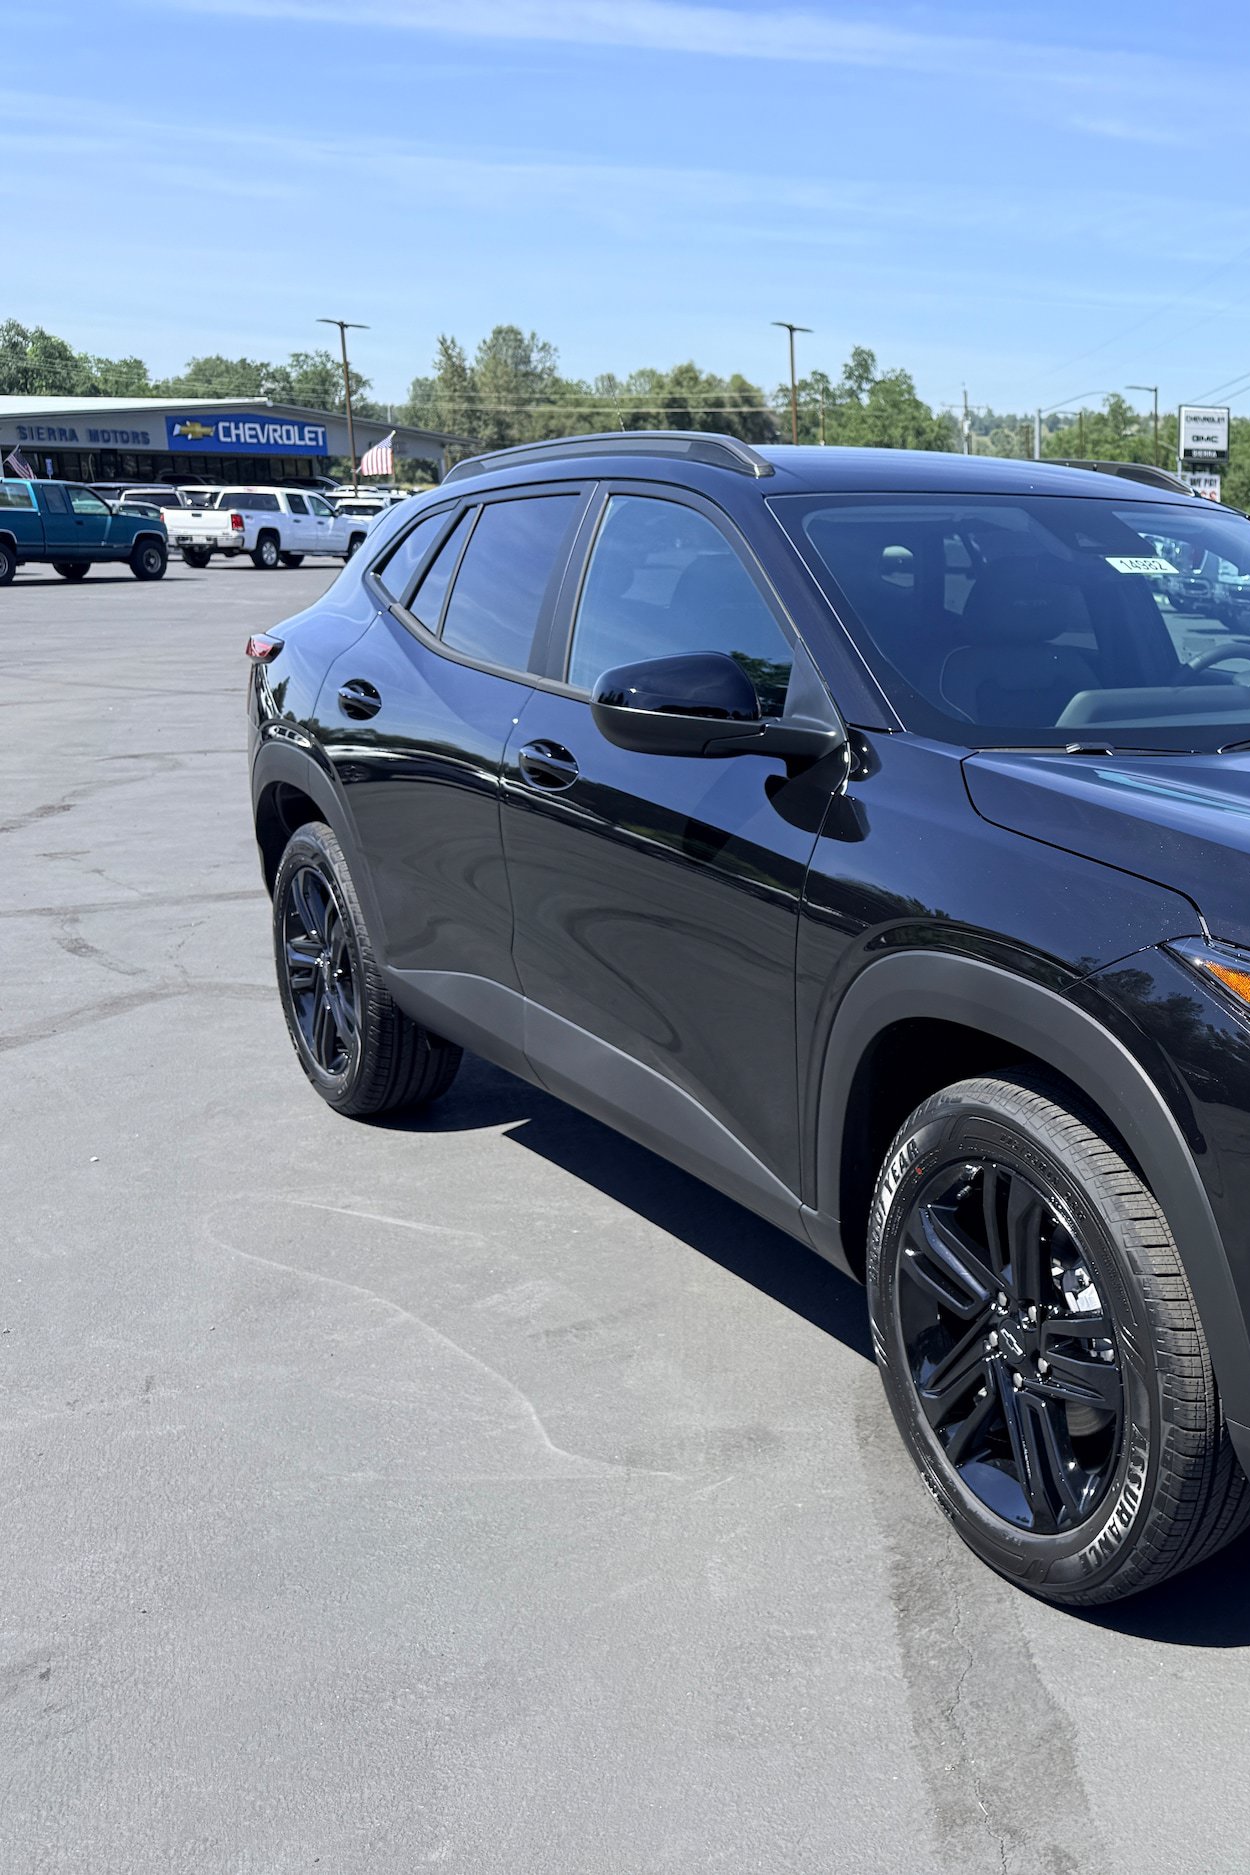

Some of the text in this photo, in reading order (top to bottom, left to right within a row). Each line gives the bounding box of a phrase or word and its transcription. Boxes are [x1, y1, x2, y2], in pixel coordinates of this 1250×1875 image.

[16, 425, 151, 445] SIERRA MOTORS
[218, 421, 325, 446] CHEVROLET
[1192, 434, 1219, 443] GMC
[1078, 1422, 1150, 1576] ASSURANCE
